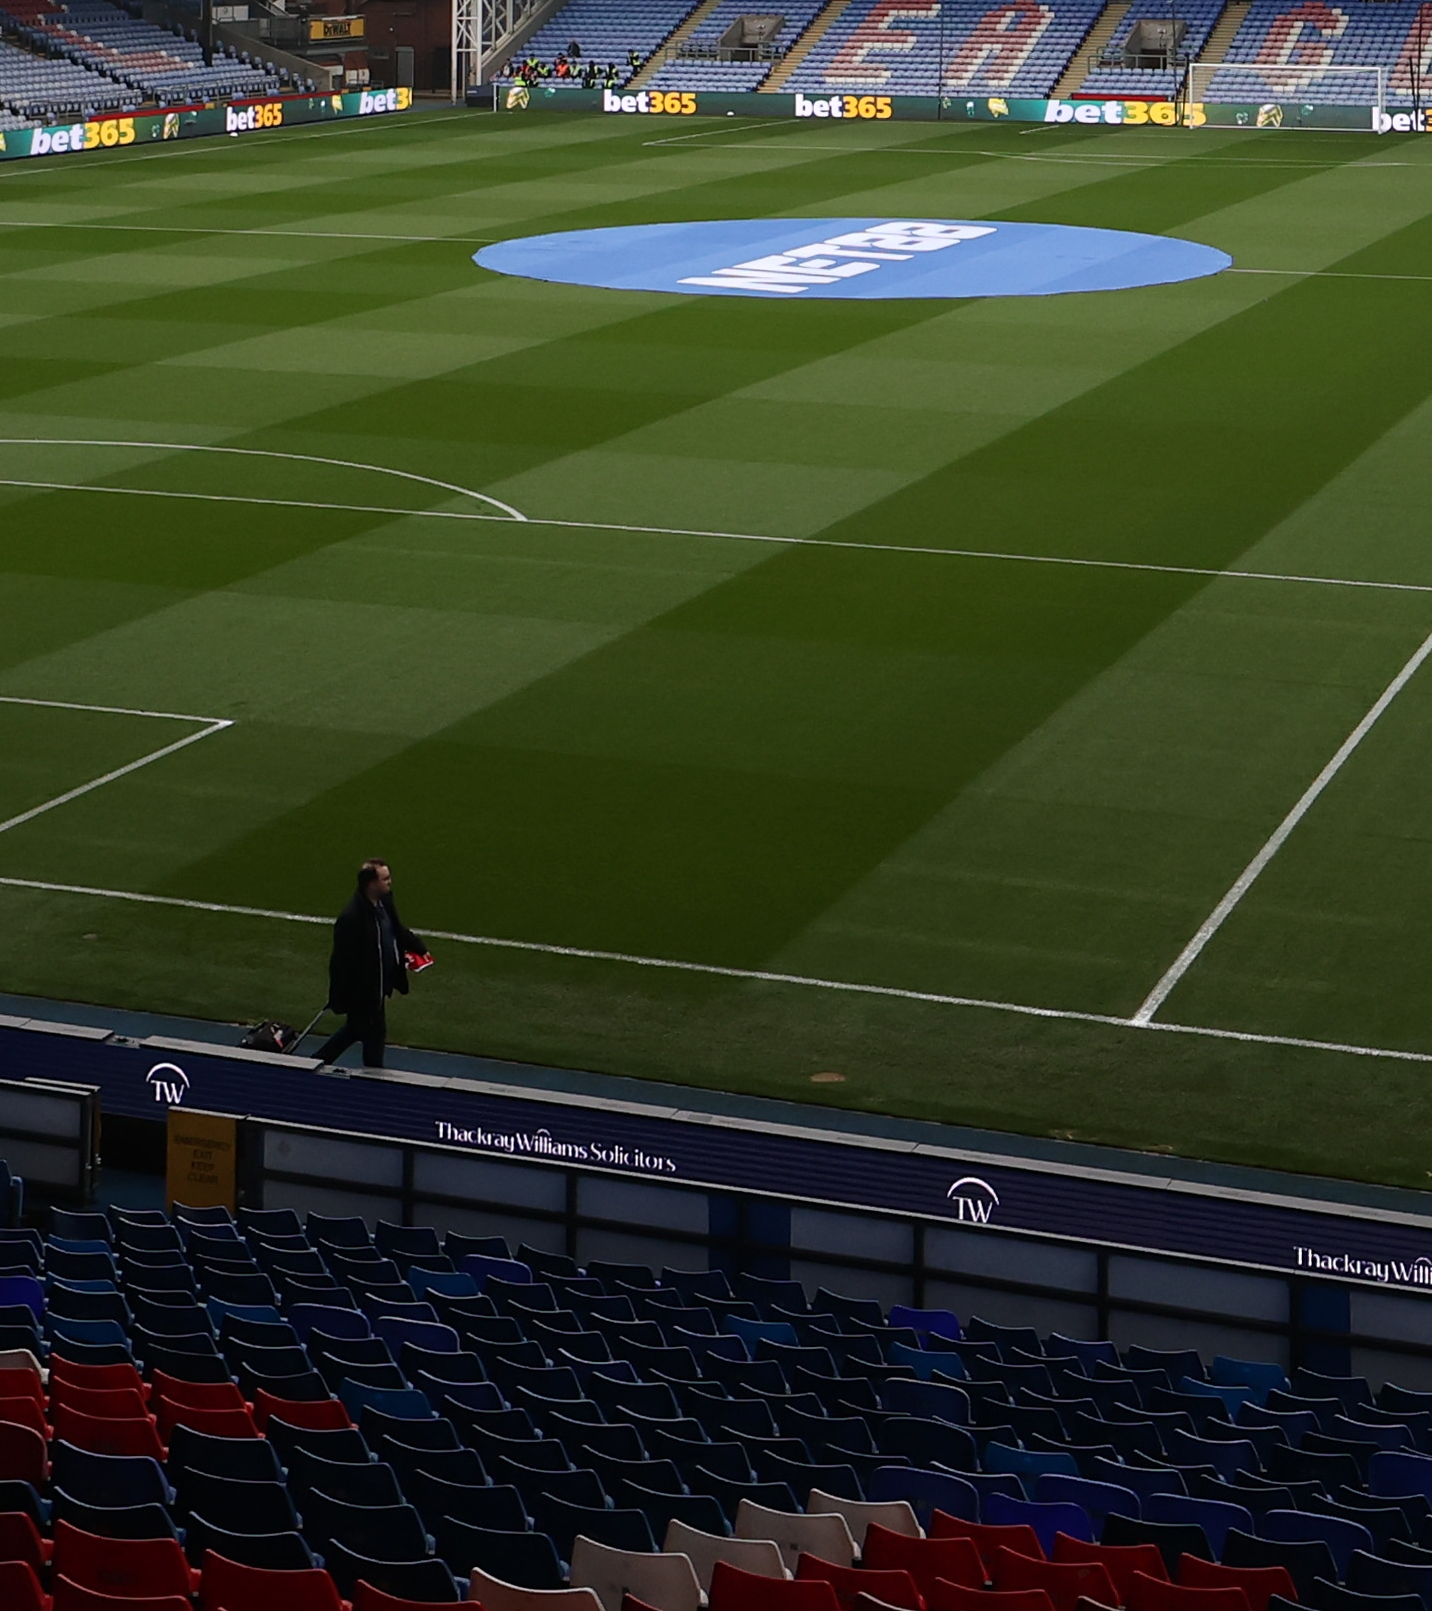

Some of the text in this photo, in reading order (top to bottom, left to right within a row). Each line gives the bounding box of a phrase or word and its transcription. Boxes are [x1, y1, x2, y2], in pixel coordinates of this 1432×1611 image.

[359, 87, 413, 115] bet3
[603, 89, 697, 114] bet365
[796, 94, 891, 118] bet365
[1044, 100, 1207, 126] bet365
[227, 103, 282, 131] bet365
[31, 118, 136, 155] bet365
[677, 221, 998, 294] NET88
[590, 1143, 677, 1173] Solicitors
